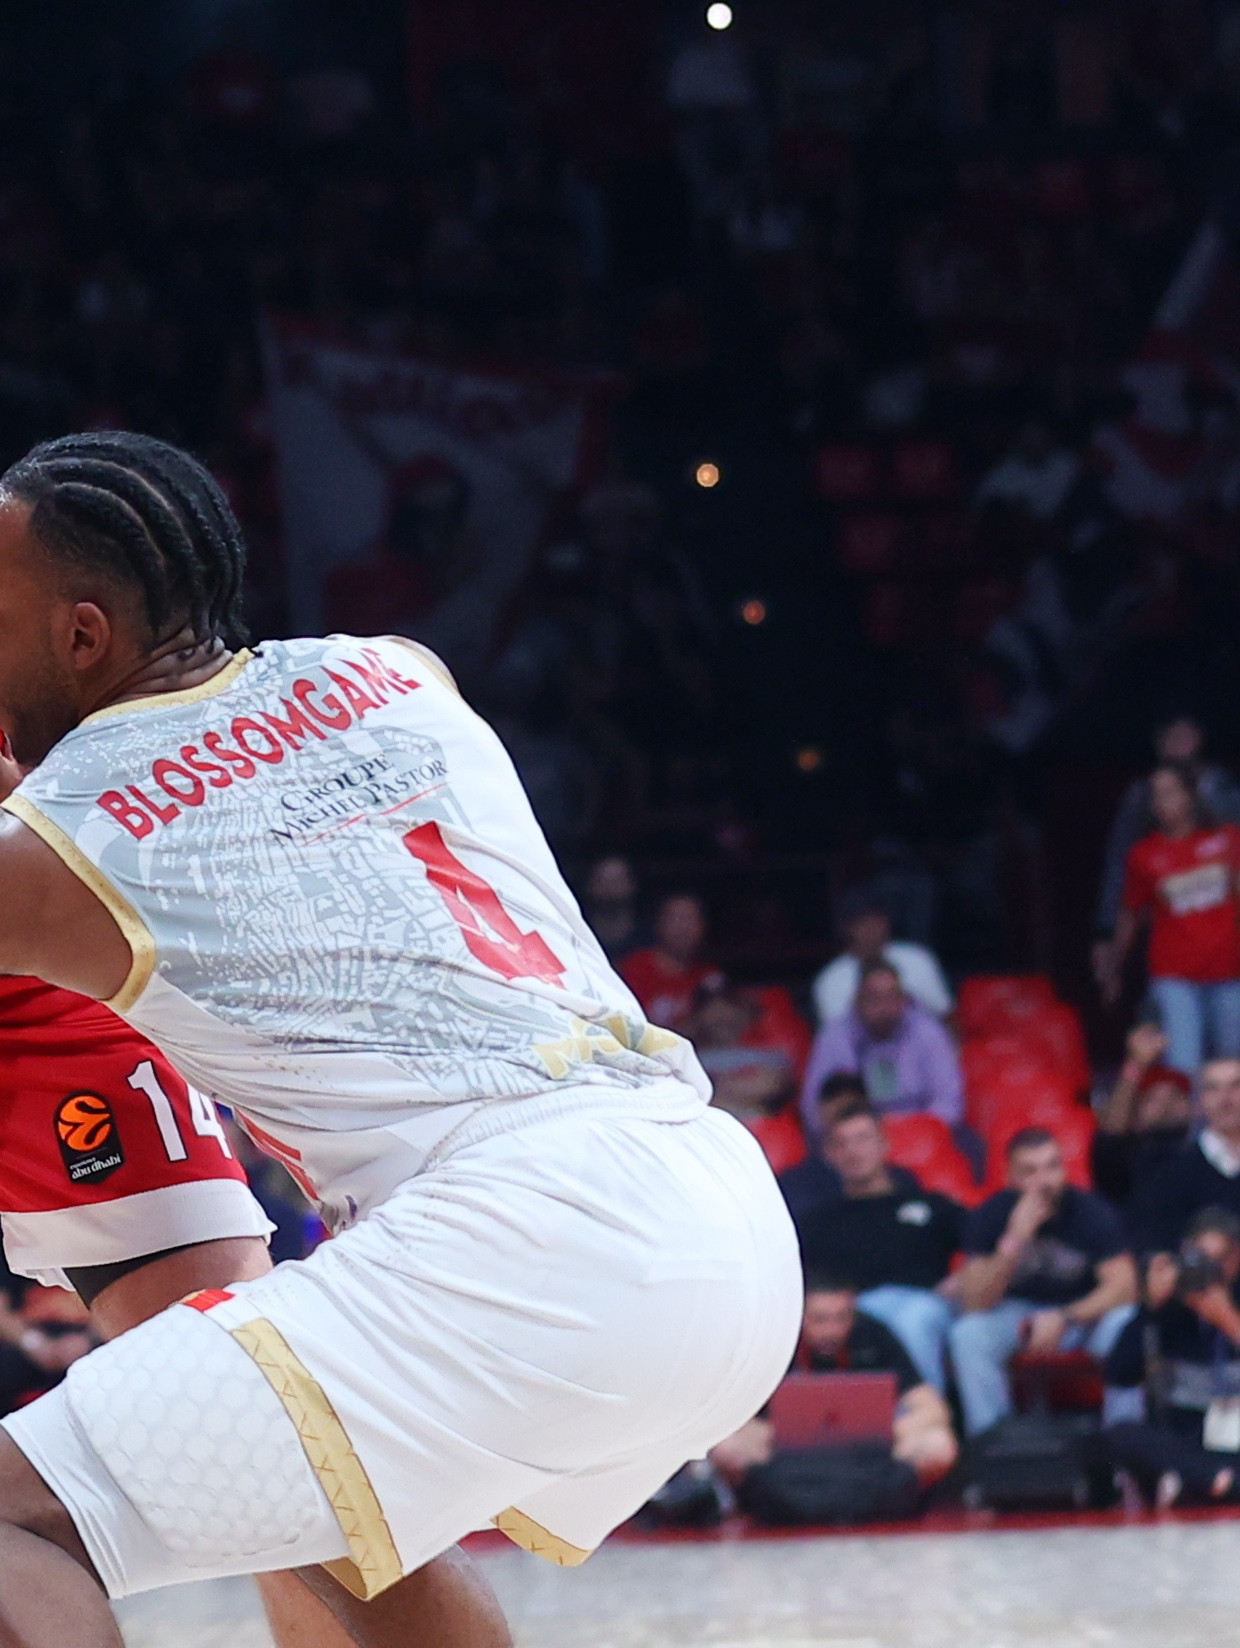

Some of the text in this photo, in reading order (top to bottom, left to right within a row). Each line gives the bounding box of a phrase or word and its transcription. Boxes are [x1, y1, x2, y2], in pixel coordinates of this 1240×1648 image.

[97, 648, 421, 840] BLOSSOMGAME
[281, 754, 394, 811] GROUPE
[364, 760, 447, 803] PASTOR
[127, 1060, 233, 1162] 14
